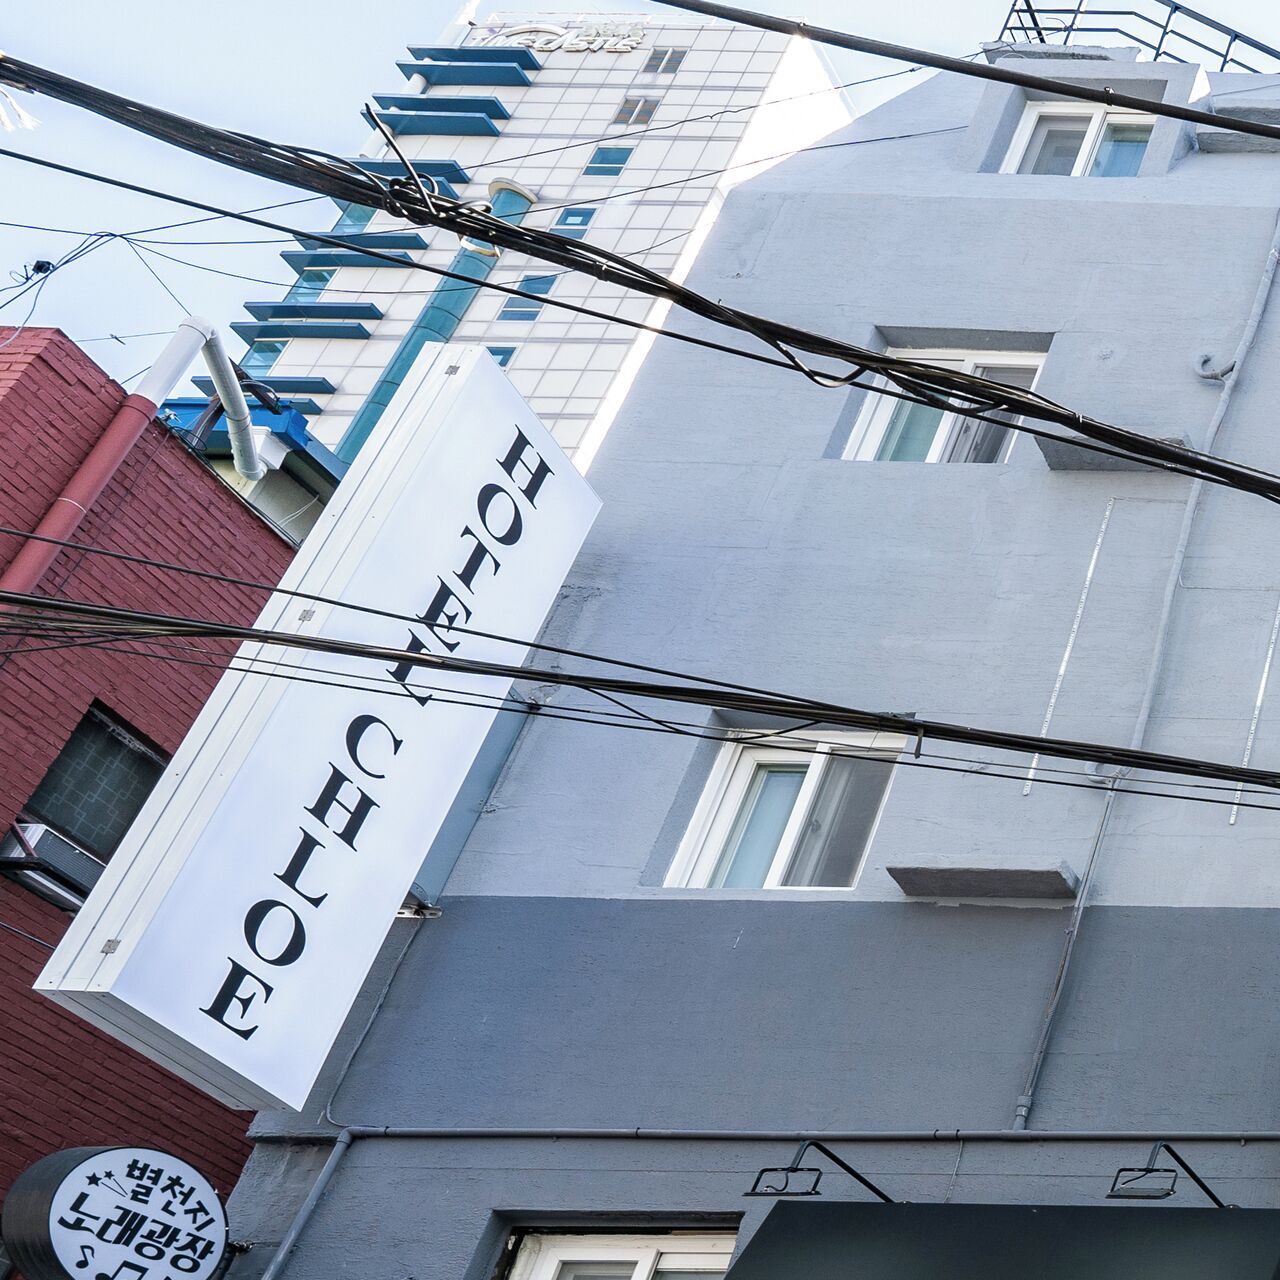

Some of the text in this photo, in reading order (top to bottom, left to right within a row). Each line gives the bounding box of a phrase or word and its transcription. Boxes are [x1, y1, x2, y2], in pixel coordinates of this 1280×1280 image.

[199, 425, 555, 1041] HOTEL CHLOE
[57, 1192, 216, 1273] 노래광장
[125, 1158, 216, 1233] 별천지
